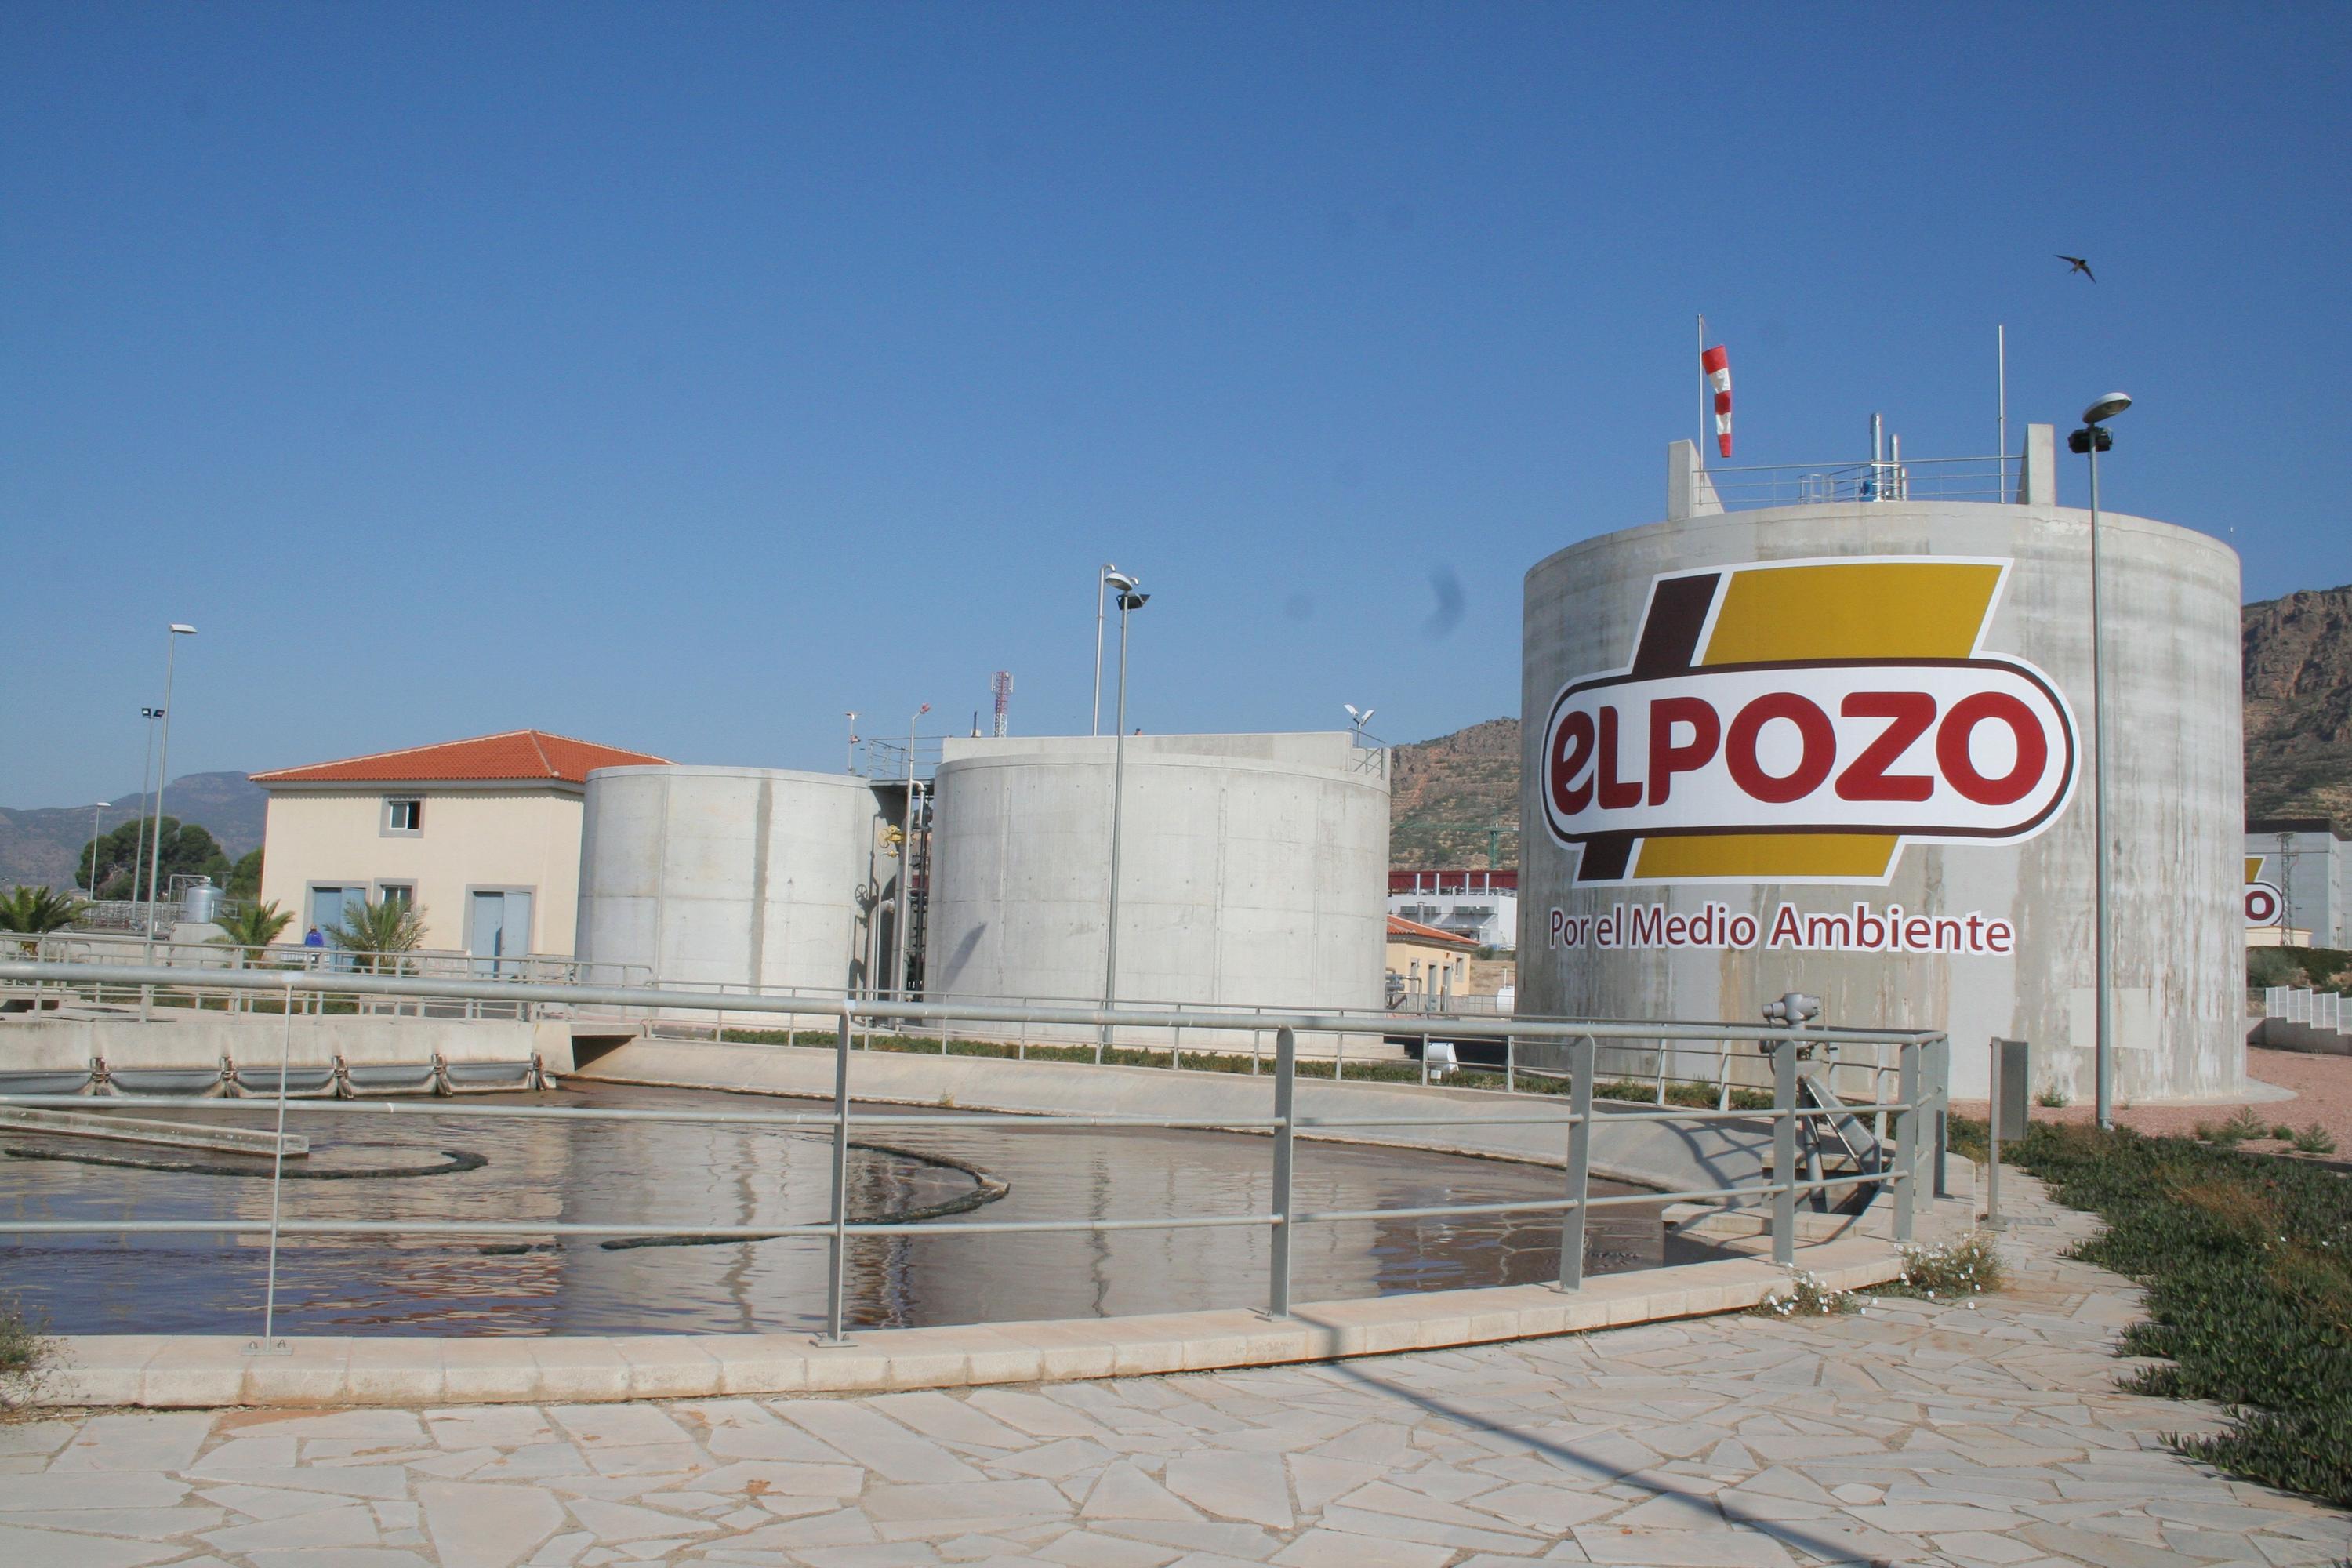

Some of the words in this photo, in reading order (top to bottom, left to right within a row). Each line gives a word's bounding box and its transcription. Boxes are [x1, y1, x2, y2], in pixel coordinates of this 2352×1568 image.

[1551, 909, 1590, 946] Por
[1595, 906, 1621, 946] el
[1631, 904, 1756, 946] Medio
[1769, 906, 2011, 953] Ambiente
